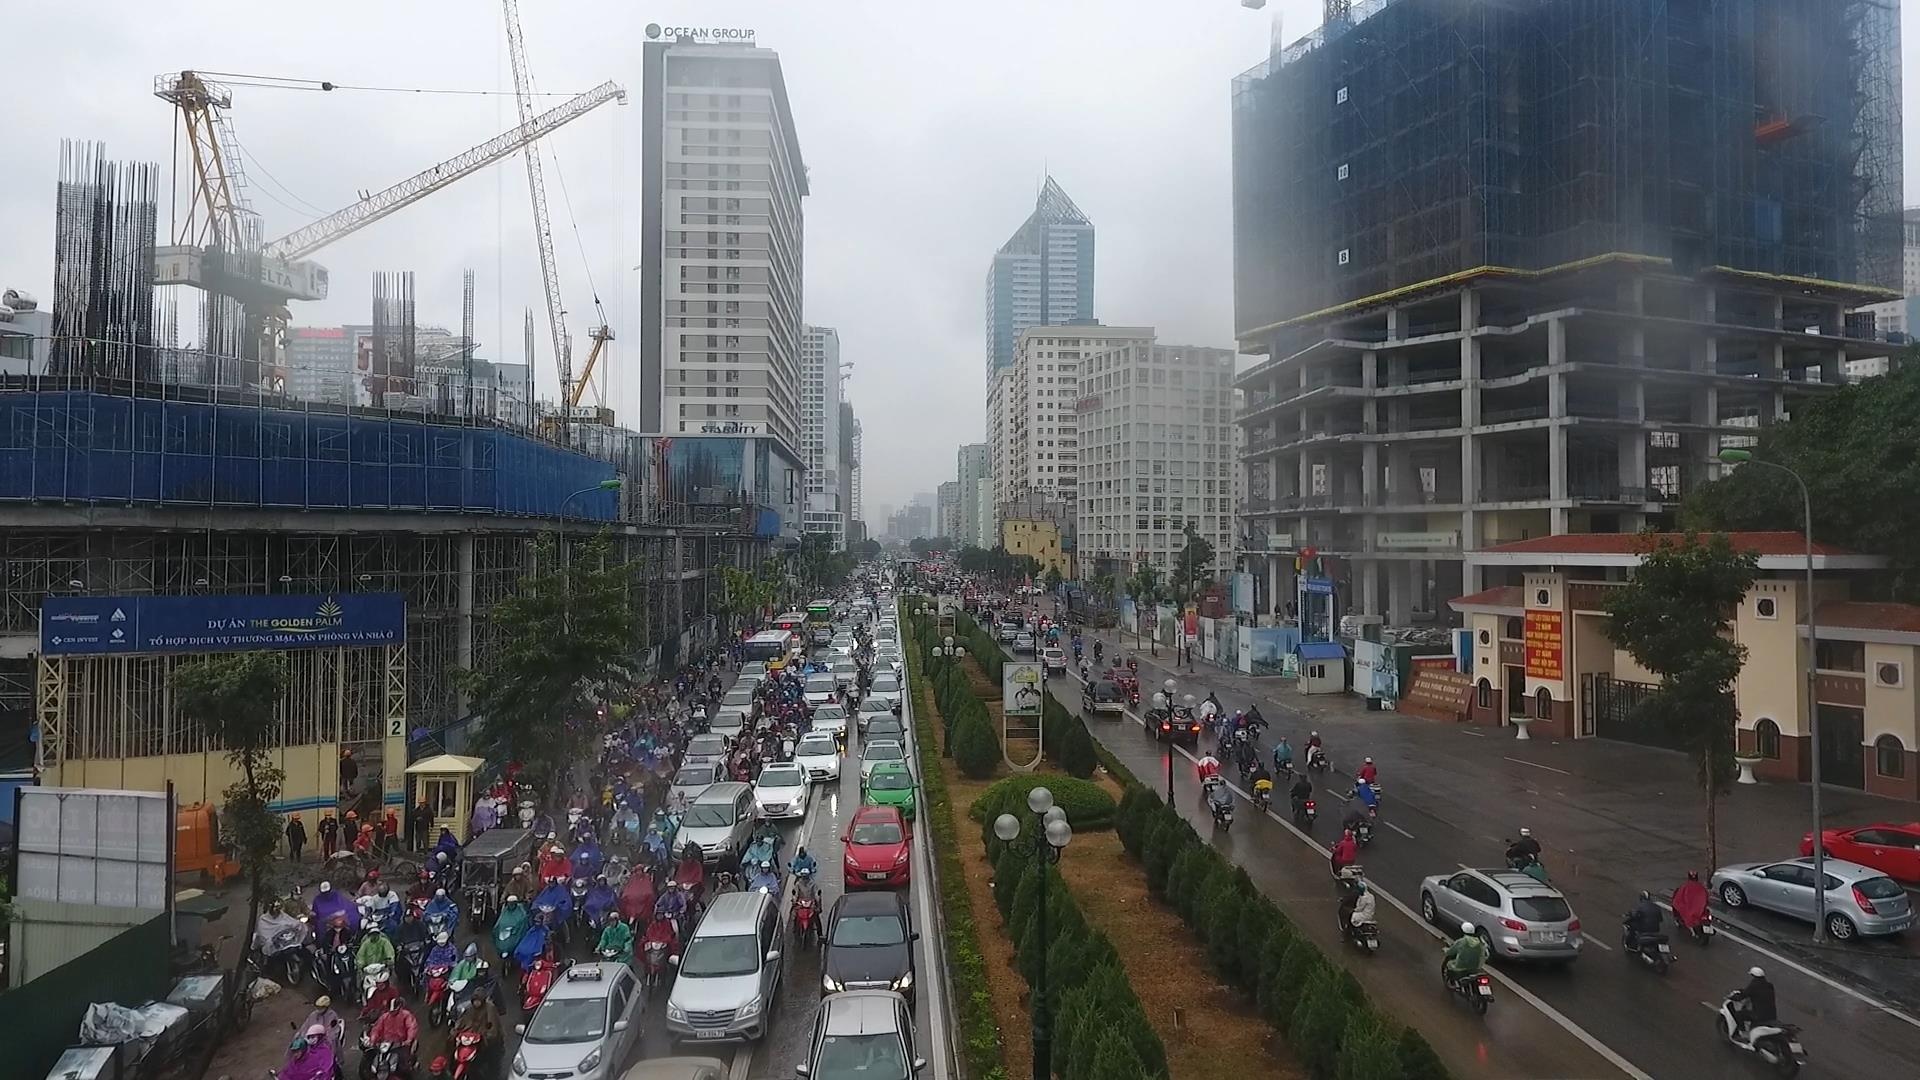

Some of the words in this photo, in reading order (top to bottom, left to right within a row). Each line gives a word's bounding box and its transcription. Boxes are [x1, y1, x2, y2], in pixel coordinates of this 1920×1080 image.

[664, 27, 708, 38] OCEAN
[712, 28, 755, 39] GROUP
[208, 618, 227, 630] DỰ
[228, 618, 246, 627] ÁN
[250, 619, 269, 627] THE
[271, 618, 313, 627] GOLDEN
[316, 617, 343, 627] PALM
[189, 636, 214, 646] DỊCH
[391, 720, 401, 735] 2
